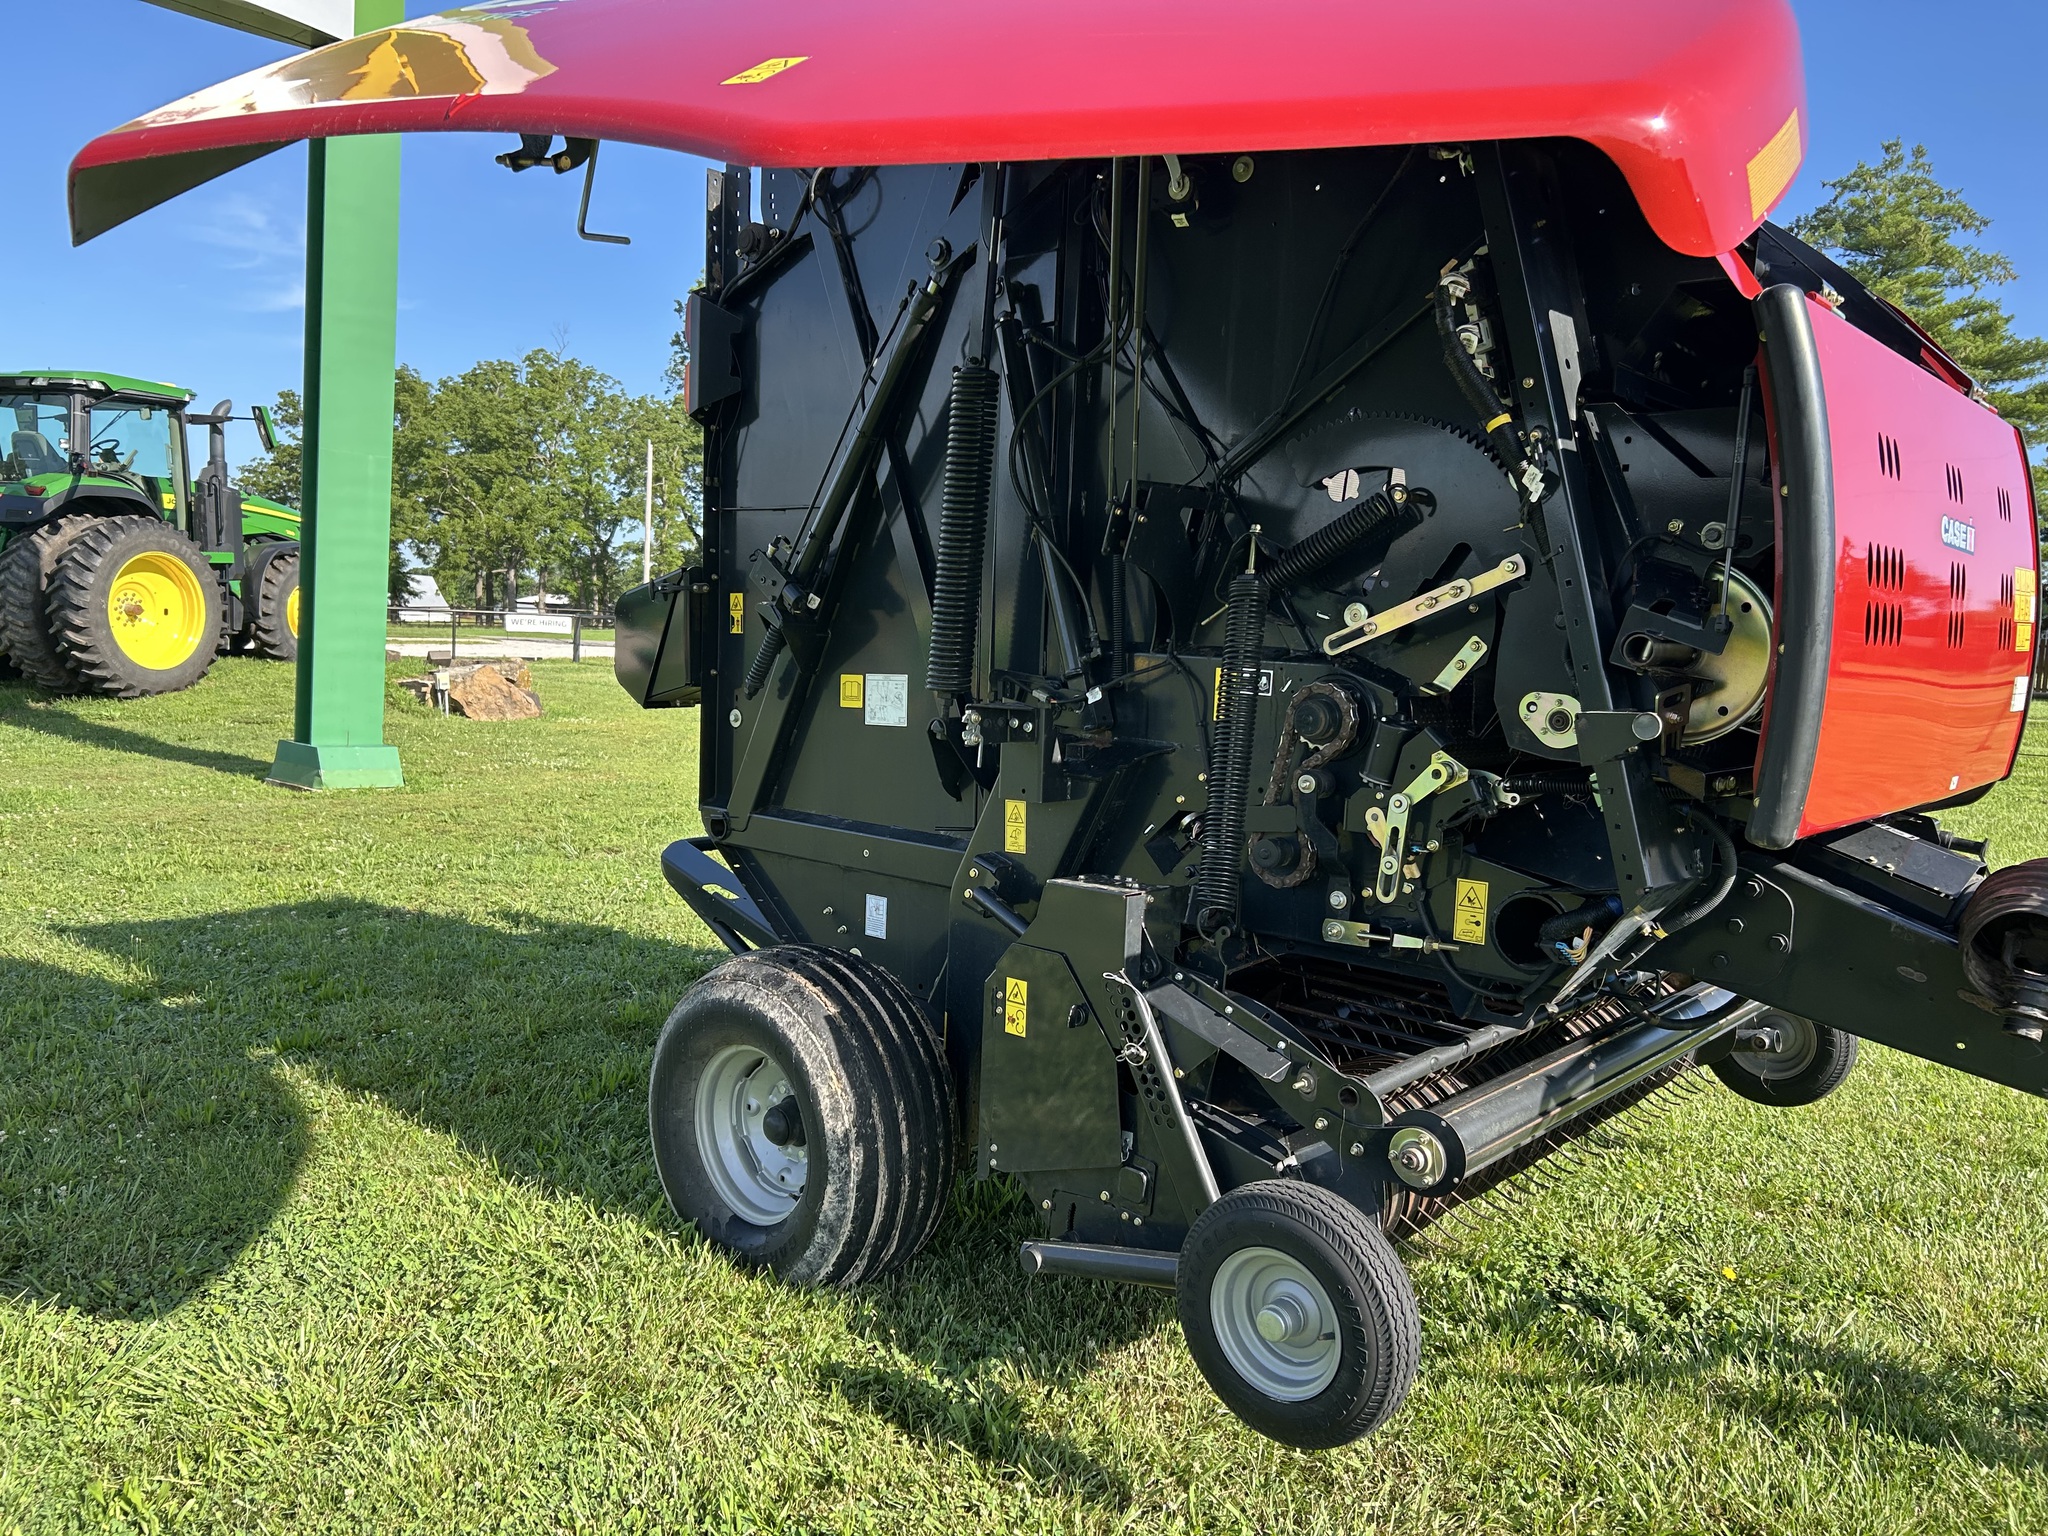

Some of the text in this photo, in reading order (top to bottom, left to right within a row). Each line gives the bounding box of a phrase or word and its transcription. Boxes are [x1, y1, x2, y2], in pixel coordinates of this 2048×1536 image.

[1941, 515, 1967, 549] CASE
[511, 618, 567, 628] WE'RE HIRING
[1336, 1282, 1370, 1386] SPORT
